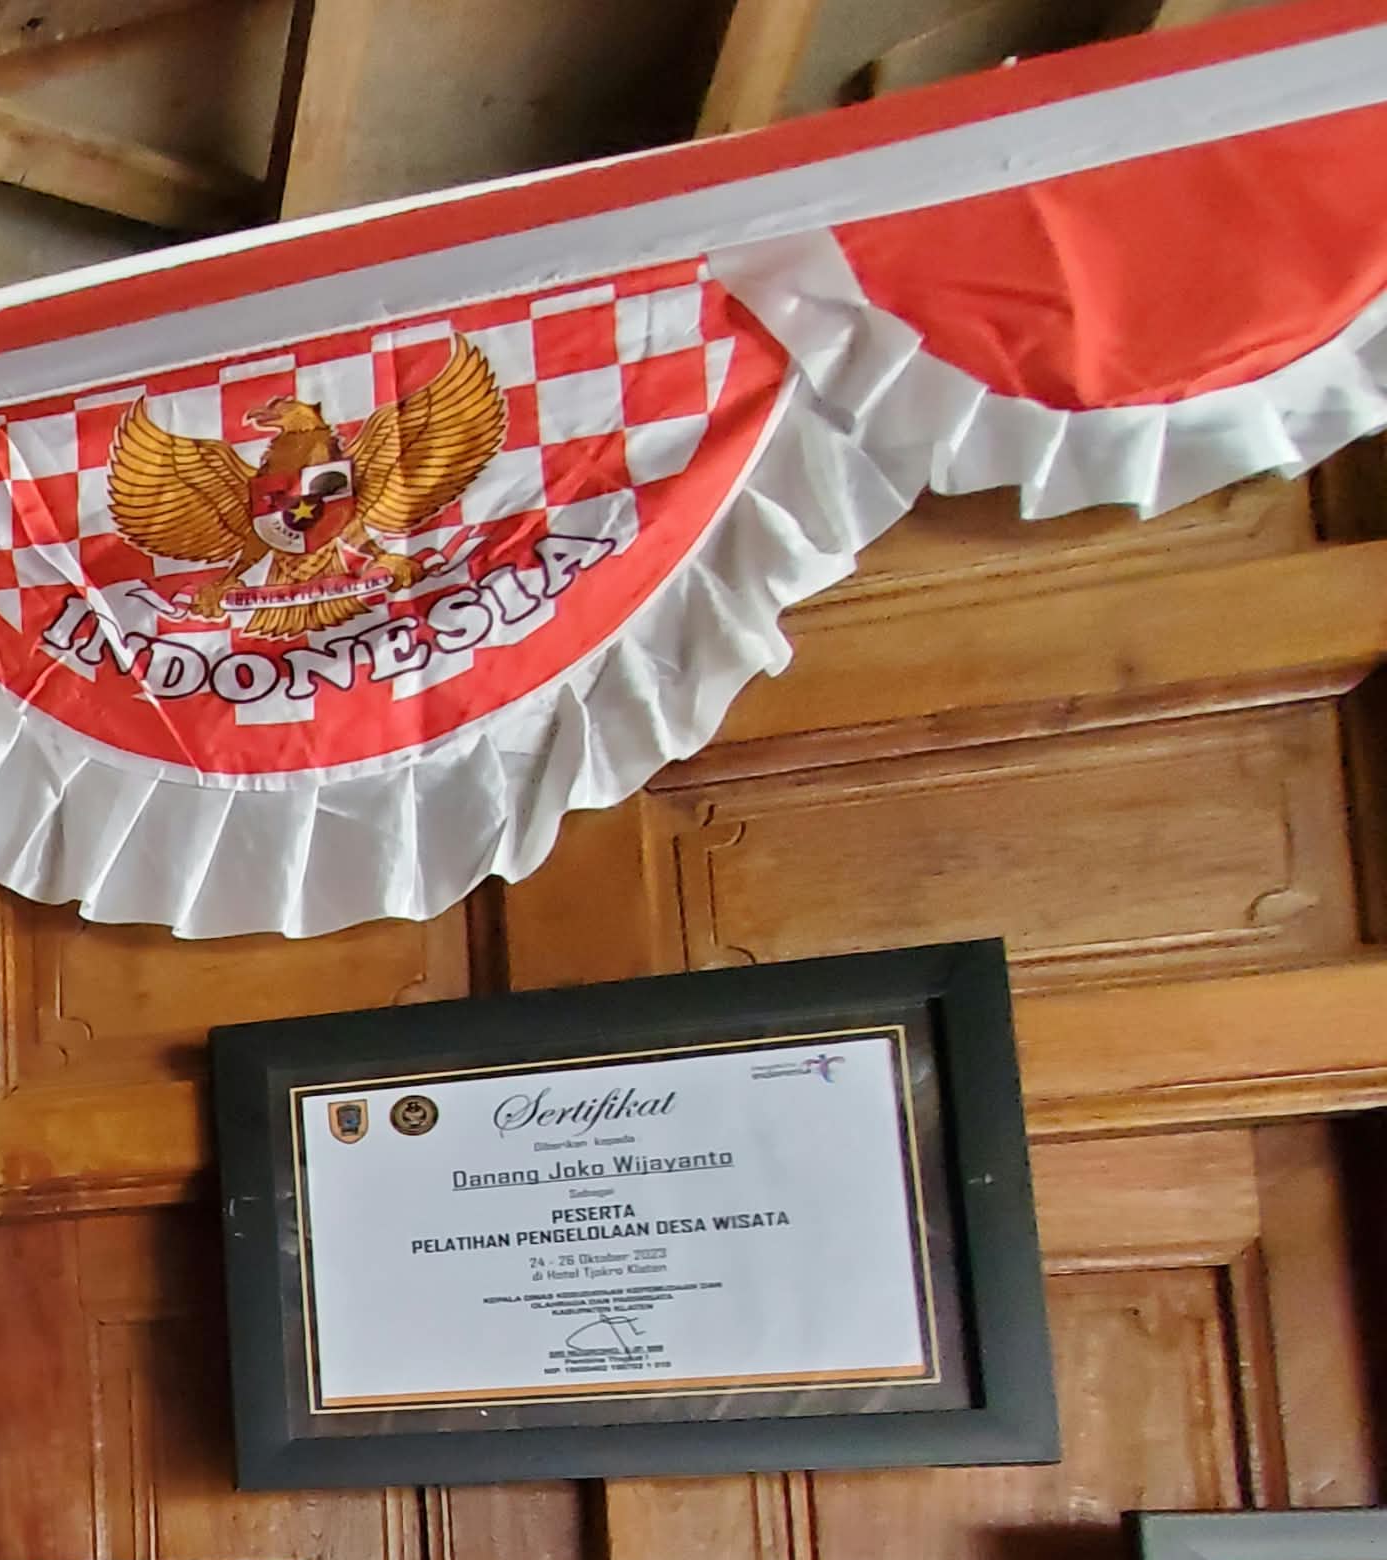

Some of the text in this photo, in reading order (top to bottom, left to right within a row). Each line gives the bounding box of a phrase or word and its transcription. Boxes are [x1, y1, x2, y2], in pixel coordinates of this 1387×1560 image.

[41, 531, 619, 705] INDONESIA
[493, 1087, 678, 1139] Sertifikat
[452, 1151, 734, 1189] Danang Joko Wijayanto
[411, 1211, 790, 1255] PELATIHAN PENGELOLAAN DESA WISATA
[551, 1204, 636, 1225] PESERTA
